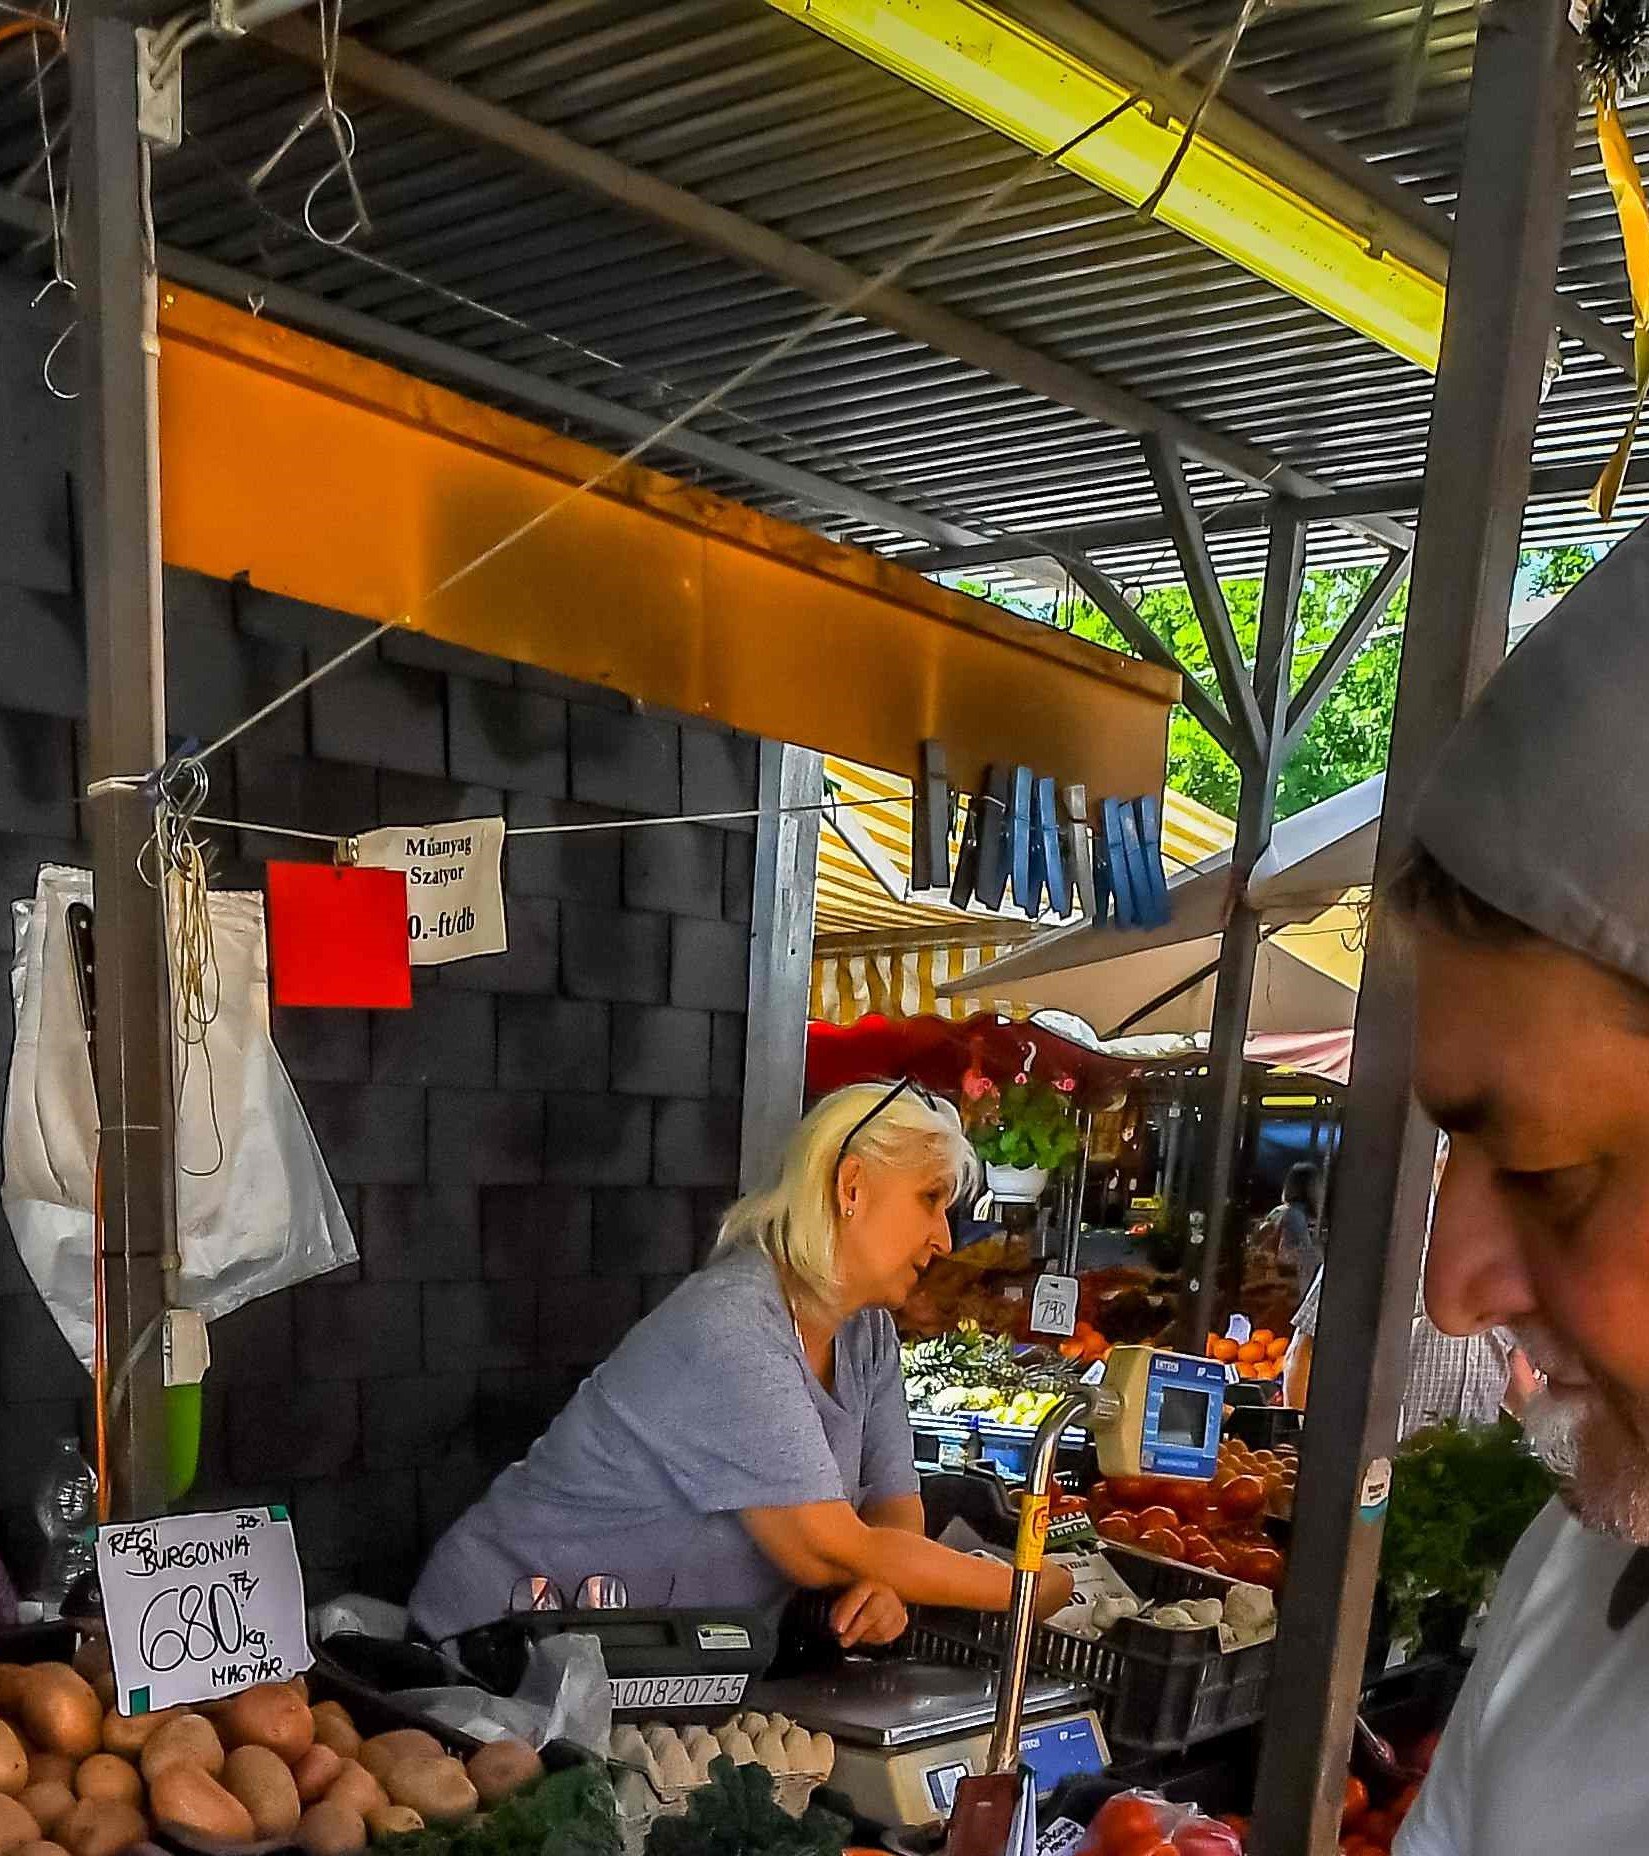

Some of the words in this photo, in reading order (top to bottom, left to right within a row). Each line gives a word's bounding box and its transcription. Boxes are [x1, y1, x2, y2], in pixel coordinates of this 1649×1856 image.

[410, 866, 465, 887] Szatyor
[408, 905, 475, 940] 0.-ft/db
[126, 1534, 250, 1577] BURGONYA
[139, 1583, 243, 1672] 680
